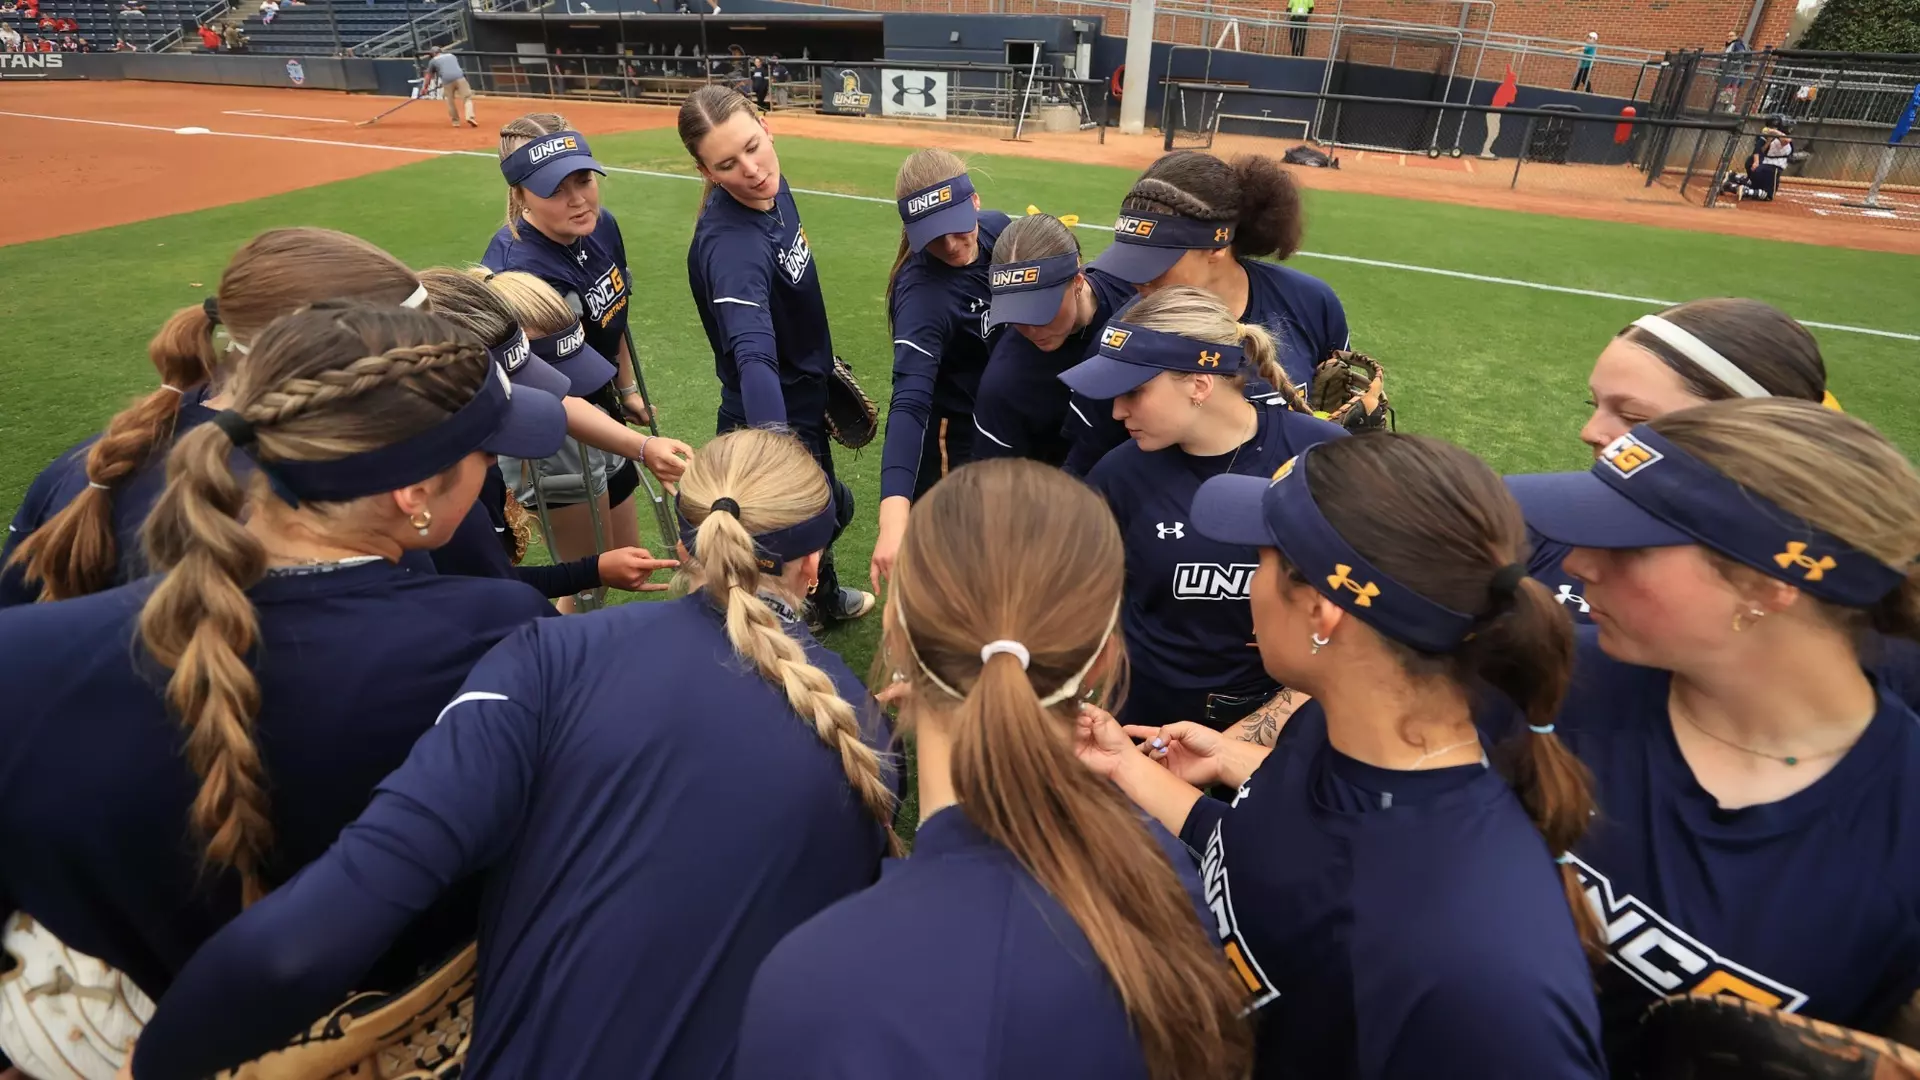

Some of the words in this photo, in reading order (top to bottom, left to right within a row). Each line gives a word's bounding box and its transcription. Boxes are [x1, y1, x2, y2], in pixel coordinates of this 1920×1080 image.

[0, 54, 63, 68] TANS
[832, 92, 871, 107] UNCG
[529, 137, 578, 164] UNCG
[908, 186, 951, 216] UNCG
[993, 266, 1040, 288] UNCG
